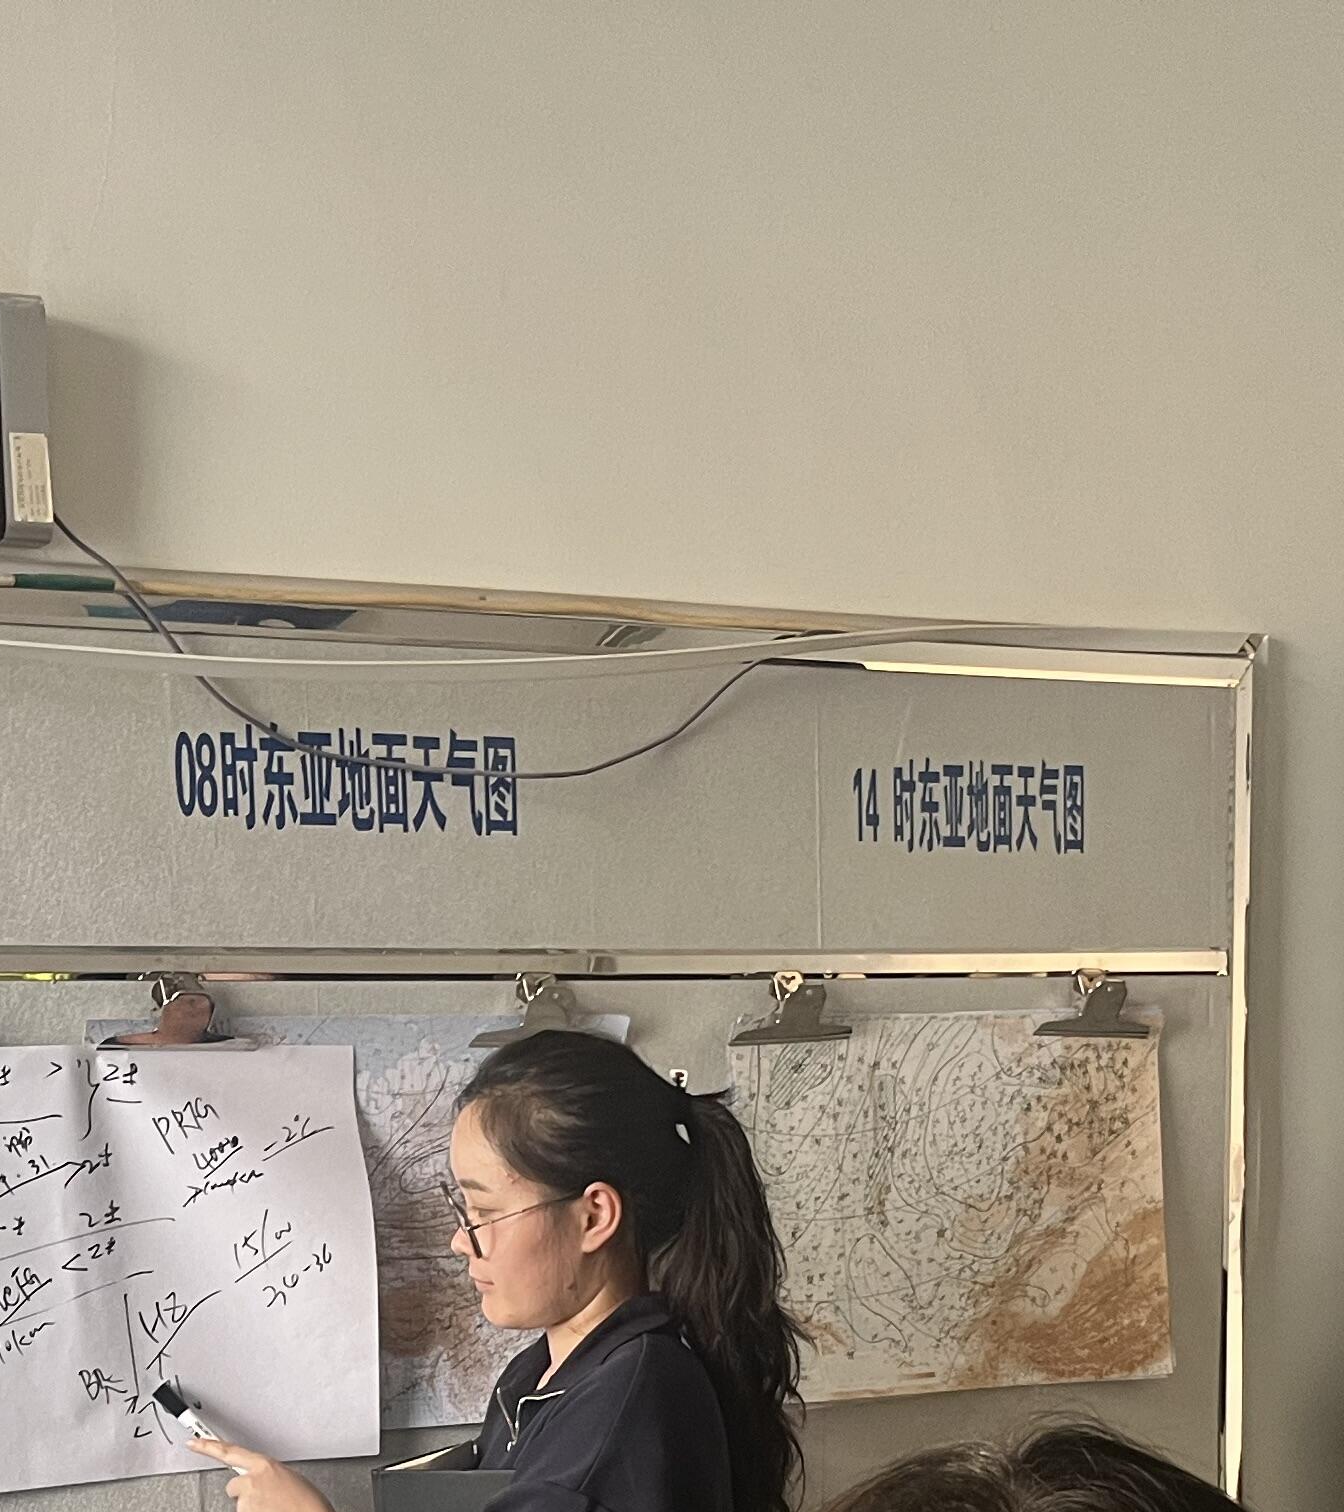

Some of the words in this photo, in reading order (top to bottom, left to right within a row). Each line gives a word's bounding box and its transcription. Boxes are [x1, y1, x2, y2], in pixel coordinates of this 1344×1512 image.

[173, 725, 520, 838] 08时东亚地面天气图
[891, 758, 1087, 855] 时东亚地面天气图
